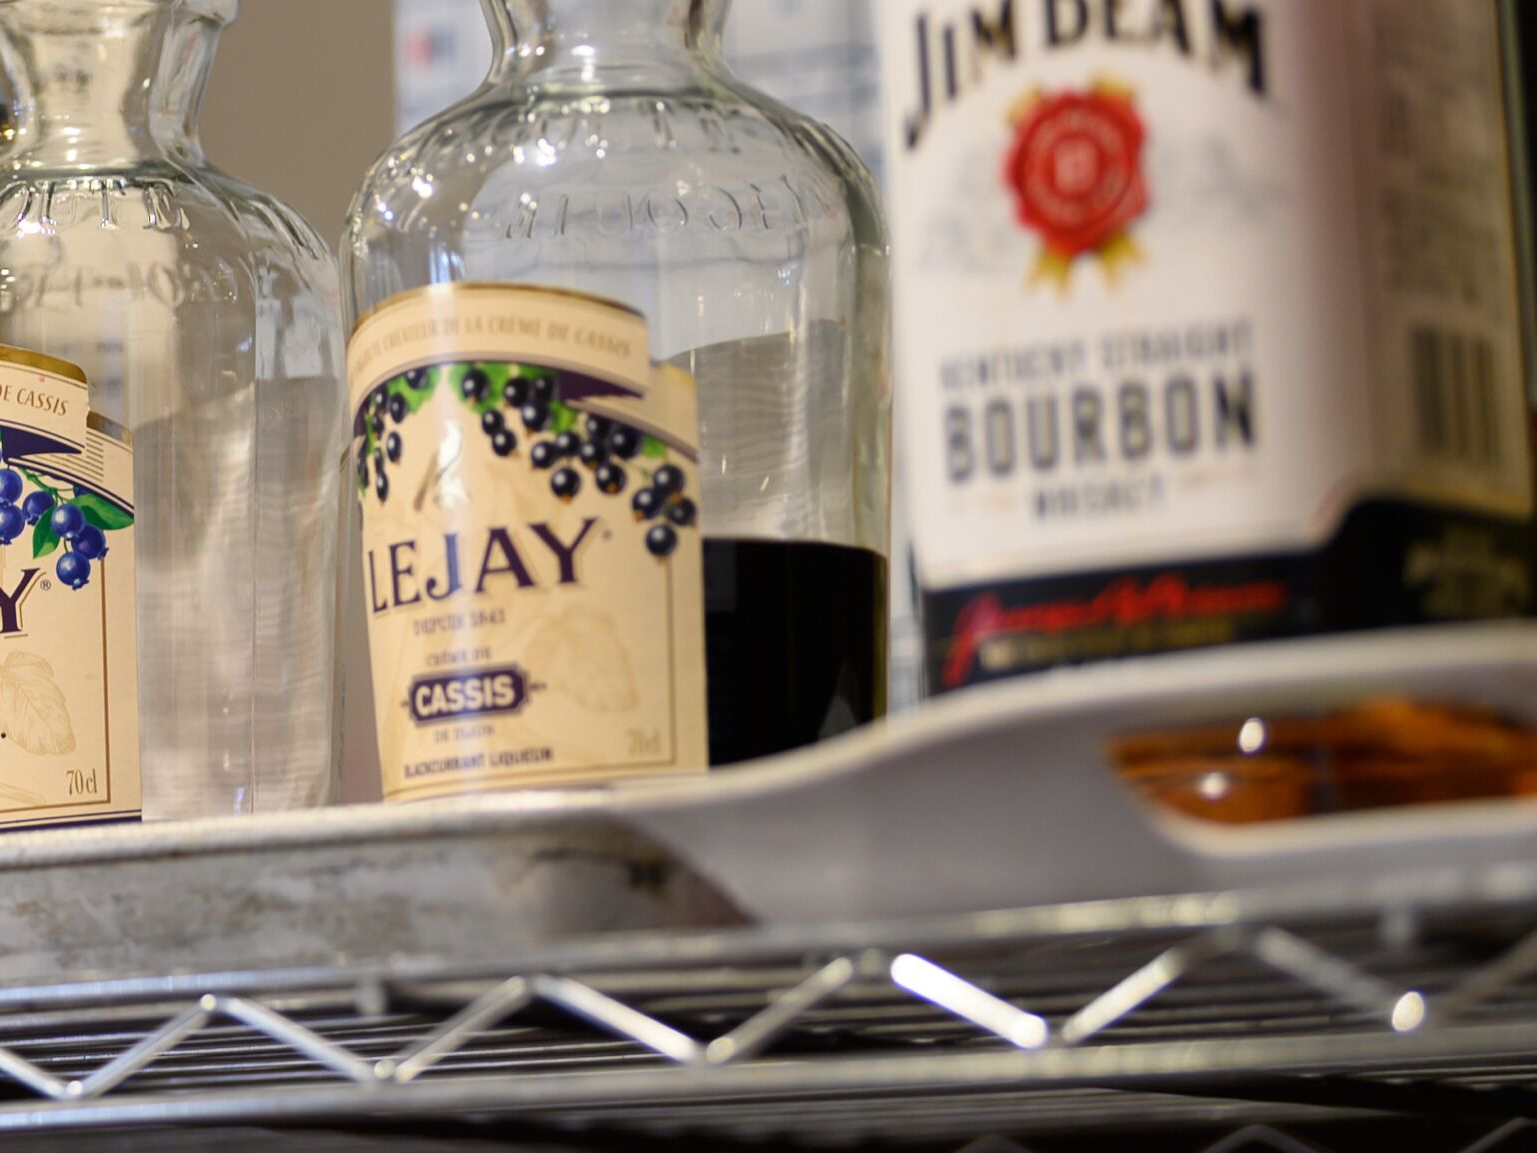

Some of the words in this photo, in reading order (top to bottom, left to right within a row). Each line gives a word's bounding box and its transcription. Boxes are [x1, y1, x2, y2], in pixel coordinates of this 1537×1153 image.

[16, 387, 69, 416] CASSIS
[945, 367, 1257, 485] BOURBON
[367, 516, 600, 615] LEJAY
[414, 674, 515, 717] CASSIS
